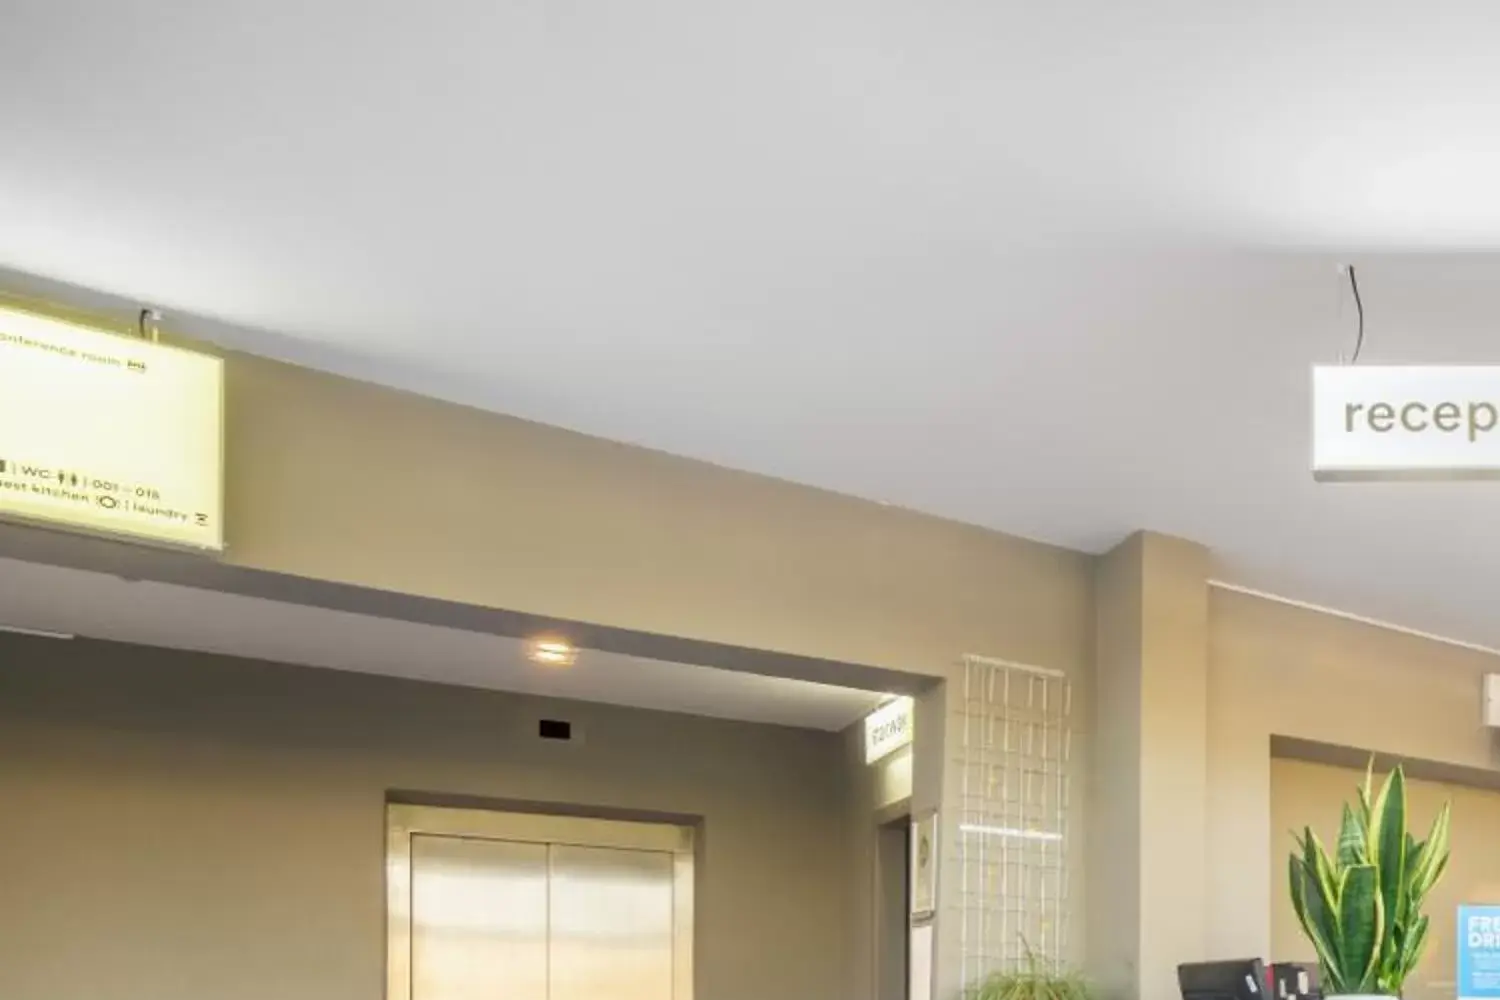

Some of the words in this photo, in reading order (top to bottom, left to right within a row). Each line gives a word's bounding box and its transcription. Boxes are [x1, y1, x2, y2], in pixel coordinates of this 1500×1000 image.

[21, 465, 49, 479] WC
[32, 483, 90, 503] kitchen
[133, 502, 188, 523] laundry
